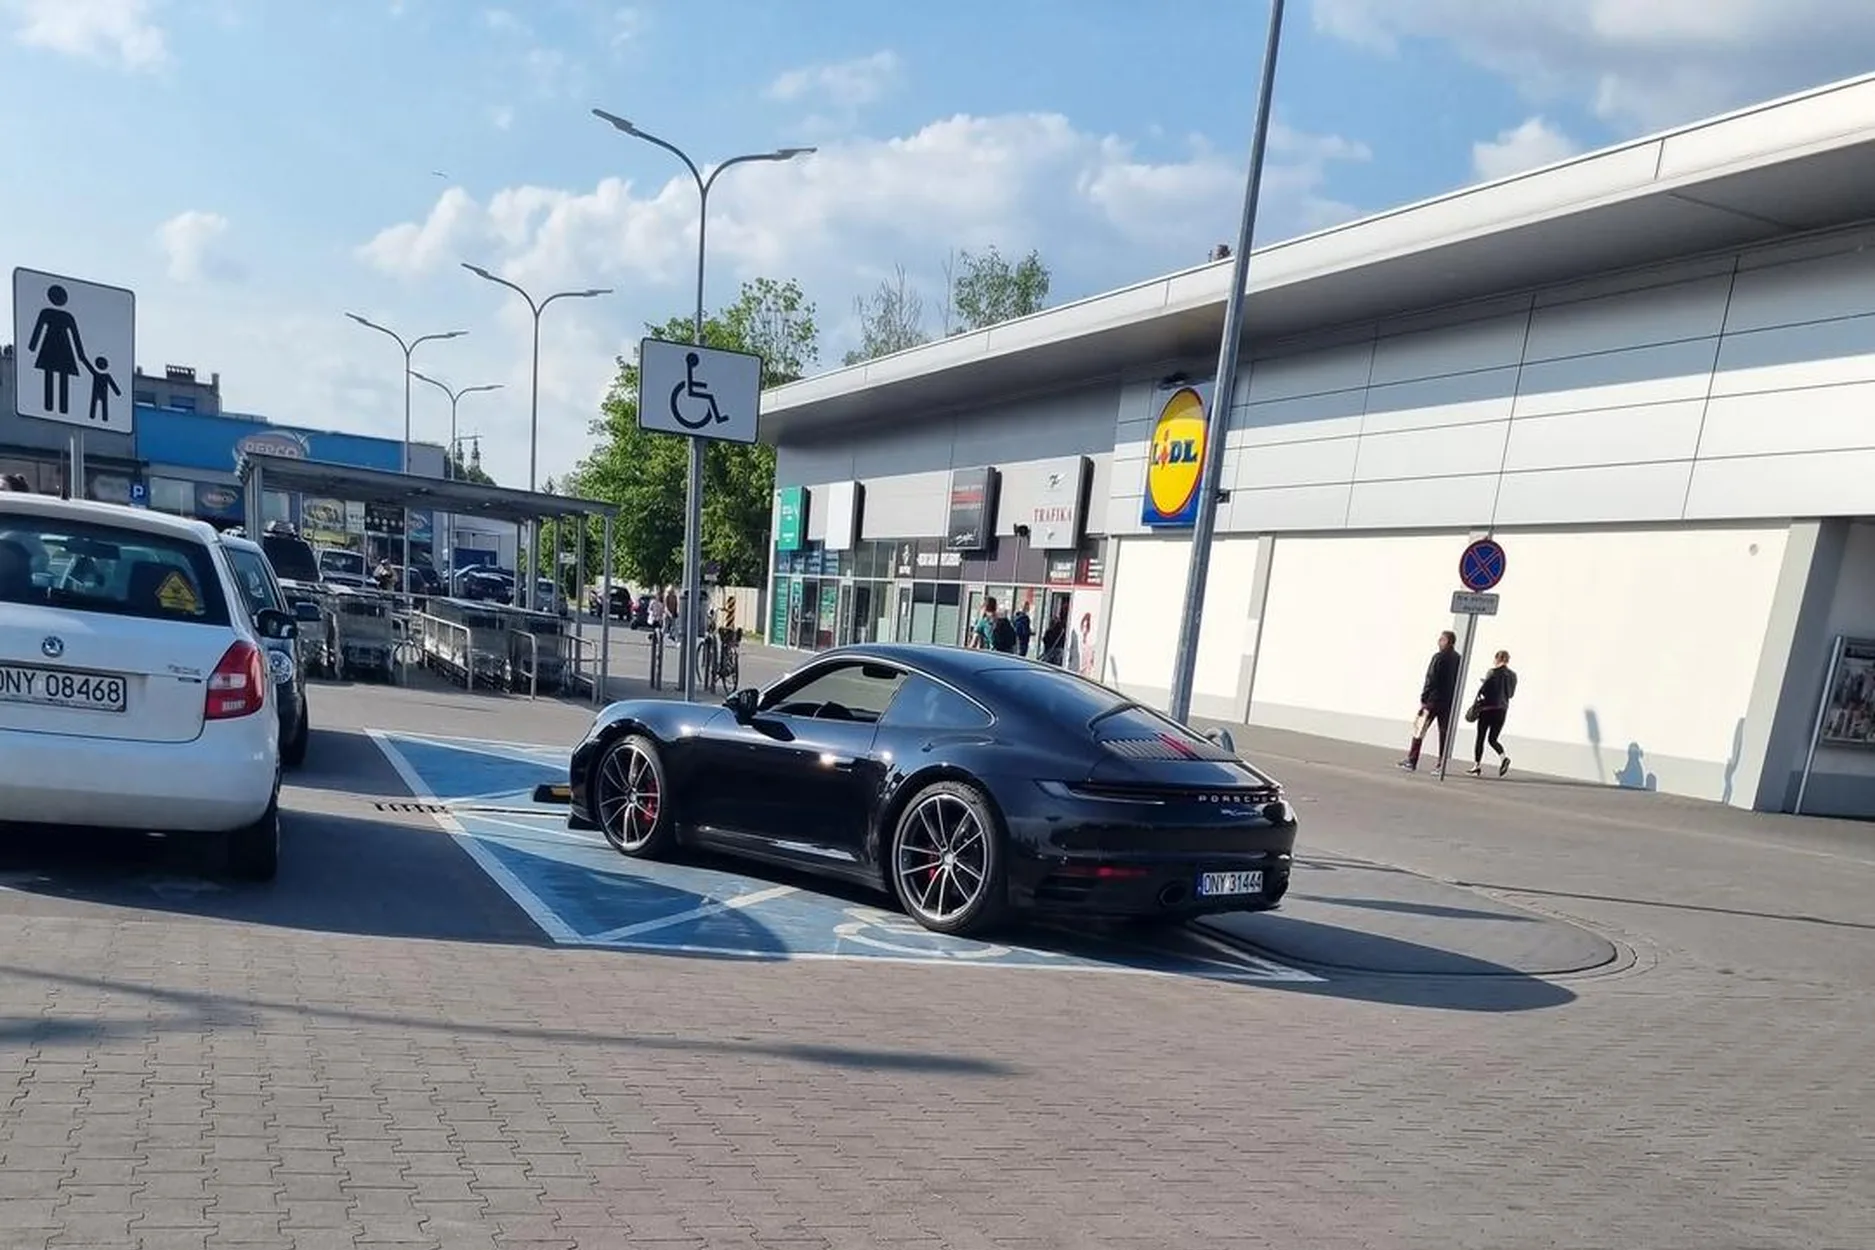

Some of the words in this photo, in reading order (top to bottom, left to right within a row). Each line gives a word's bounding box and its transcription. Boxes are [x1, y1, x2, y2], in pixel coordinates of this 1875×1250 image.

[133, 485, 144, 499] P
[1034, 507, 1072, 523] TRAFIKA
[46, 674, 120, 704] 08468
[1198, 794, 1268, 803] PORSCHE
[1229, 872, 1261, 892] 31444
